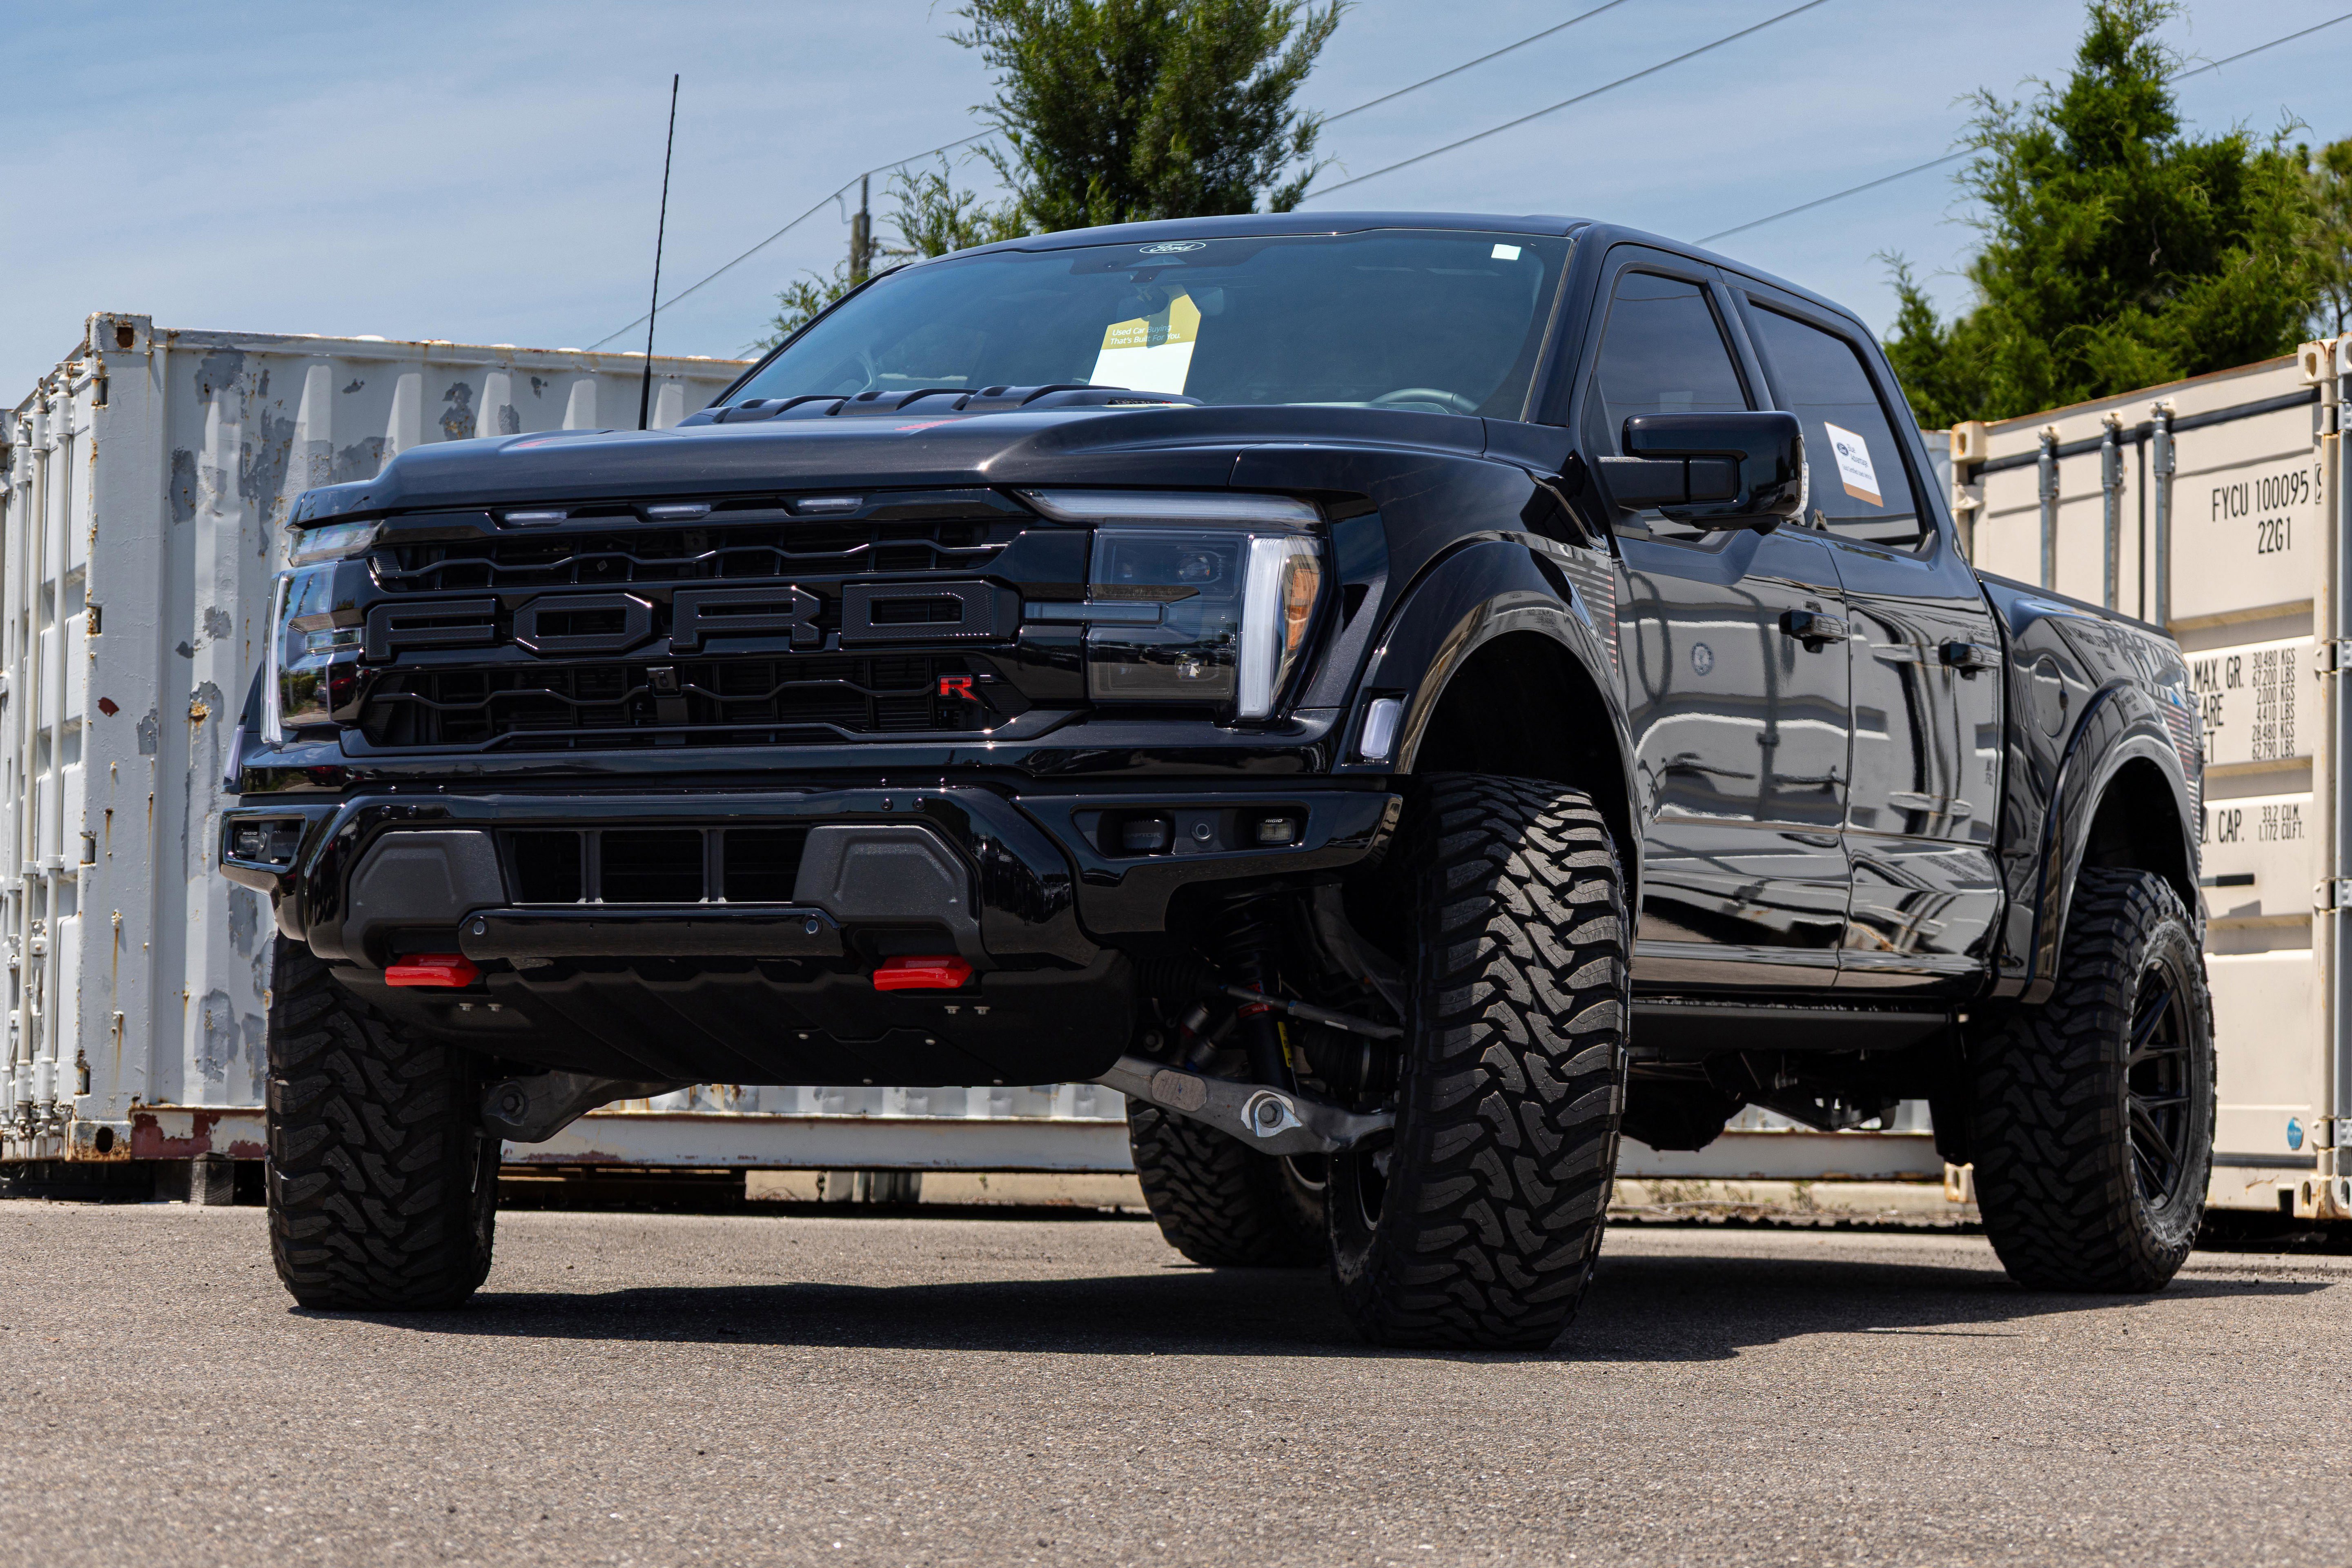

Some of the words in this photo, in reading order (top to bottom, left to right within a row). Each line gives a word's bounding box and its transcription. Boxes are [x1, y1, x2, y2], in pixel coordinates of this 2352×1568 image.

[1149, 243, 1196, 252] Ford
[1110, 336, 1132, 345] That's
[1134, 334, 1150, 343] Built
[1167, 332, 1181, 340] You.
[1112, 327, 1131, 336] Used
[1147, 325, 1172, 334] Buying
[2212, 481, 2249, 522] FYCU
[2256, 469, 2309, 512] 100095
[2258, 516, 2291, 554] 22G1
[366, 581, 1021, 662] FORD
[2252, 650, 2277, 669] 30.480
[2281, 647, 2295, 665] KGS
[2194, 658, 2220, 693] MAX.
[2227, 655, 2244, 688] GR.
[2252, 668, 2277, 687] 67.200
[2281, 666, 2295, 684] LBS
[938, 675, 981, 703] R
[2257, 686, 2277, 705] 2.000
[2281, 684, 2295, 702] KGS
[2198, 693, 2224, 727] ARE
[2256, 704, 2277, 722] 4.410
[2281, 703, 2294, 720] LBS
[2252, 723, 2277, 742] 28.480
[2281, 721, 2294, 738] KGS
[2203, 731, 2215, 764] ET
[2252, 741, 2277, 760] 62.790
[2281, 739, 2294, 757] LBS
[2262, 805, 2278, 823] 33.2
[2219, 808, 2244, 843] CAP.
[2259, 822, 2277, 842] 1.172
[2281, 820, 2304, 840] CU.FT.
